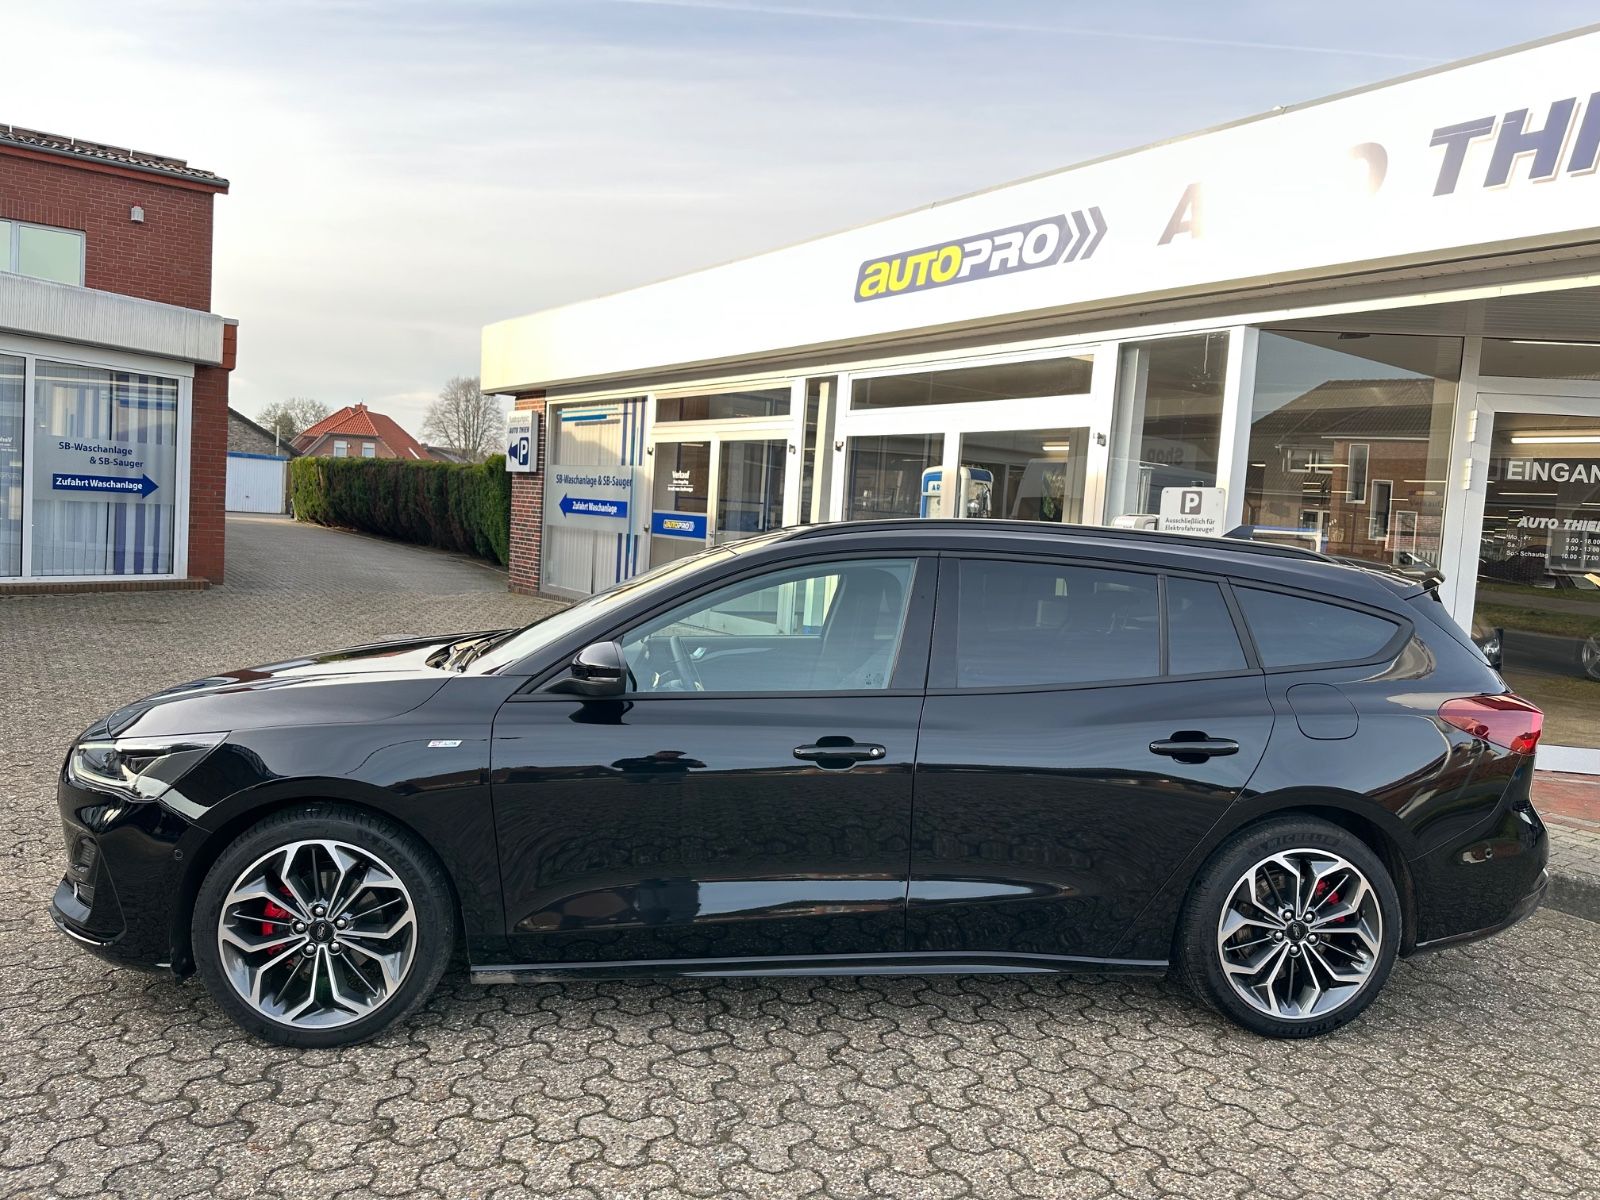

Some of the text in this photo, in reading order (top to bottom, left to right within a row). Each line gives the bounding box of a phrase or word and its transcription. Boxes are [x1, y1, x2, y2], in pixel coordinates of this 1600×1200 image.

[58, 441, 133, 457] SB-Waschanlage
[520, 439, 528, 463] P
[89, 456, 144, 469] & SB-Sauger
[55, 477, 143, 491] Zufahrt Waschanlage
[556, 474, 633, 490] SB-Waschanlage & SB-Sauger
[572, 501, 618, 515] Zufahrt Waschanlage
[1184, 493, 1200, 513] P
[1517, 516, 1559, 529] AUTO
